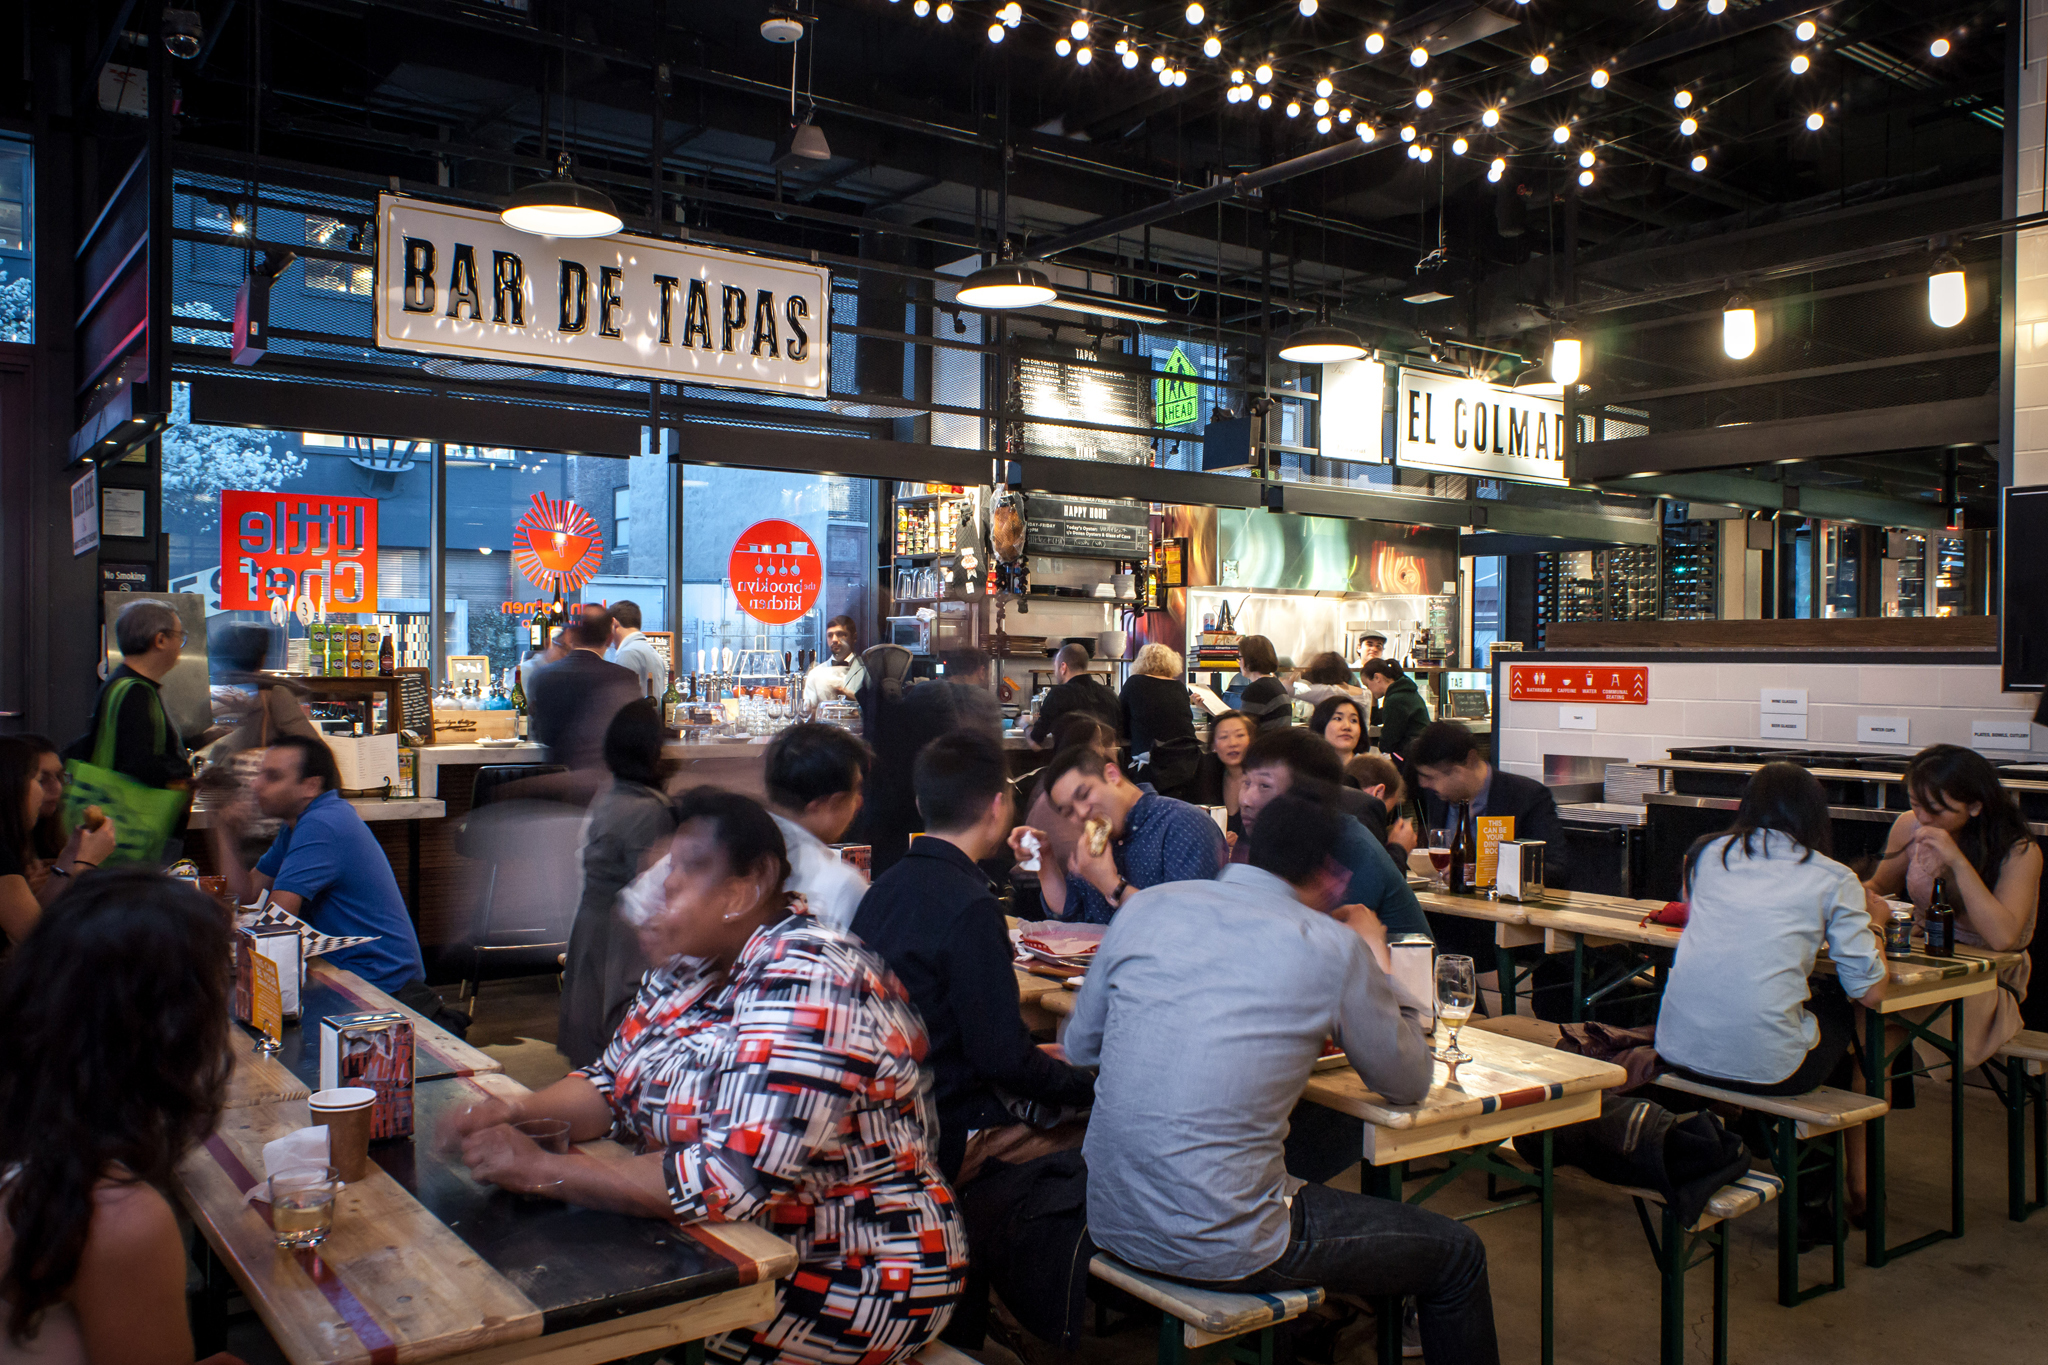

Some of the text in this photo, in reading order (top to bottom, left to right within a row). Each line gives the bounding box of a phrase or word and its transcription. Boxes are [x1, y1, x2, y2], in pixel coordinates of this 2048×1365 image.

[402, 236, 810, 362] BAR DE TAPAS
[1407, 389, 1565, 462] EL COLMAD
[1063, 504, 1108, 520] HAPPY HOUR
[104, 570, 146, 582] No Smoking
